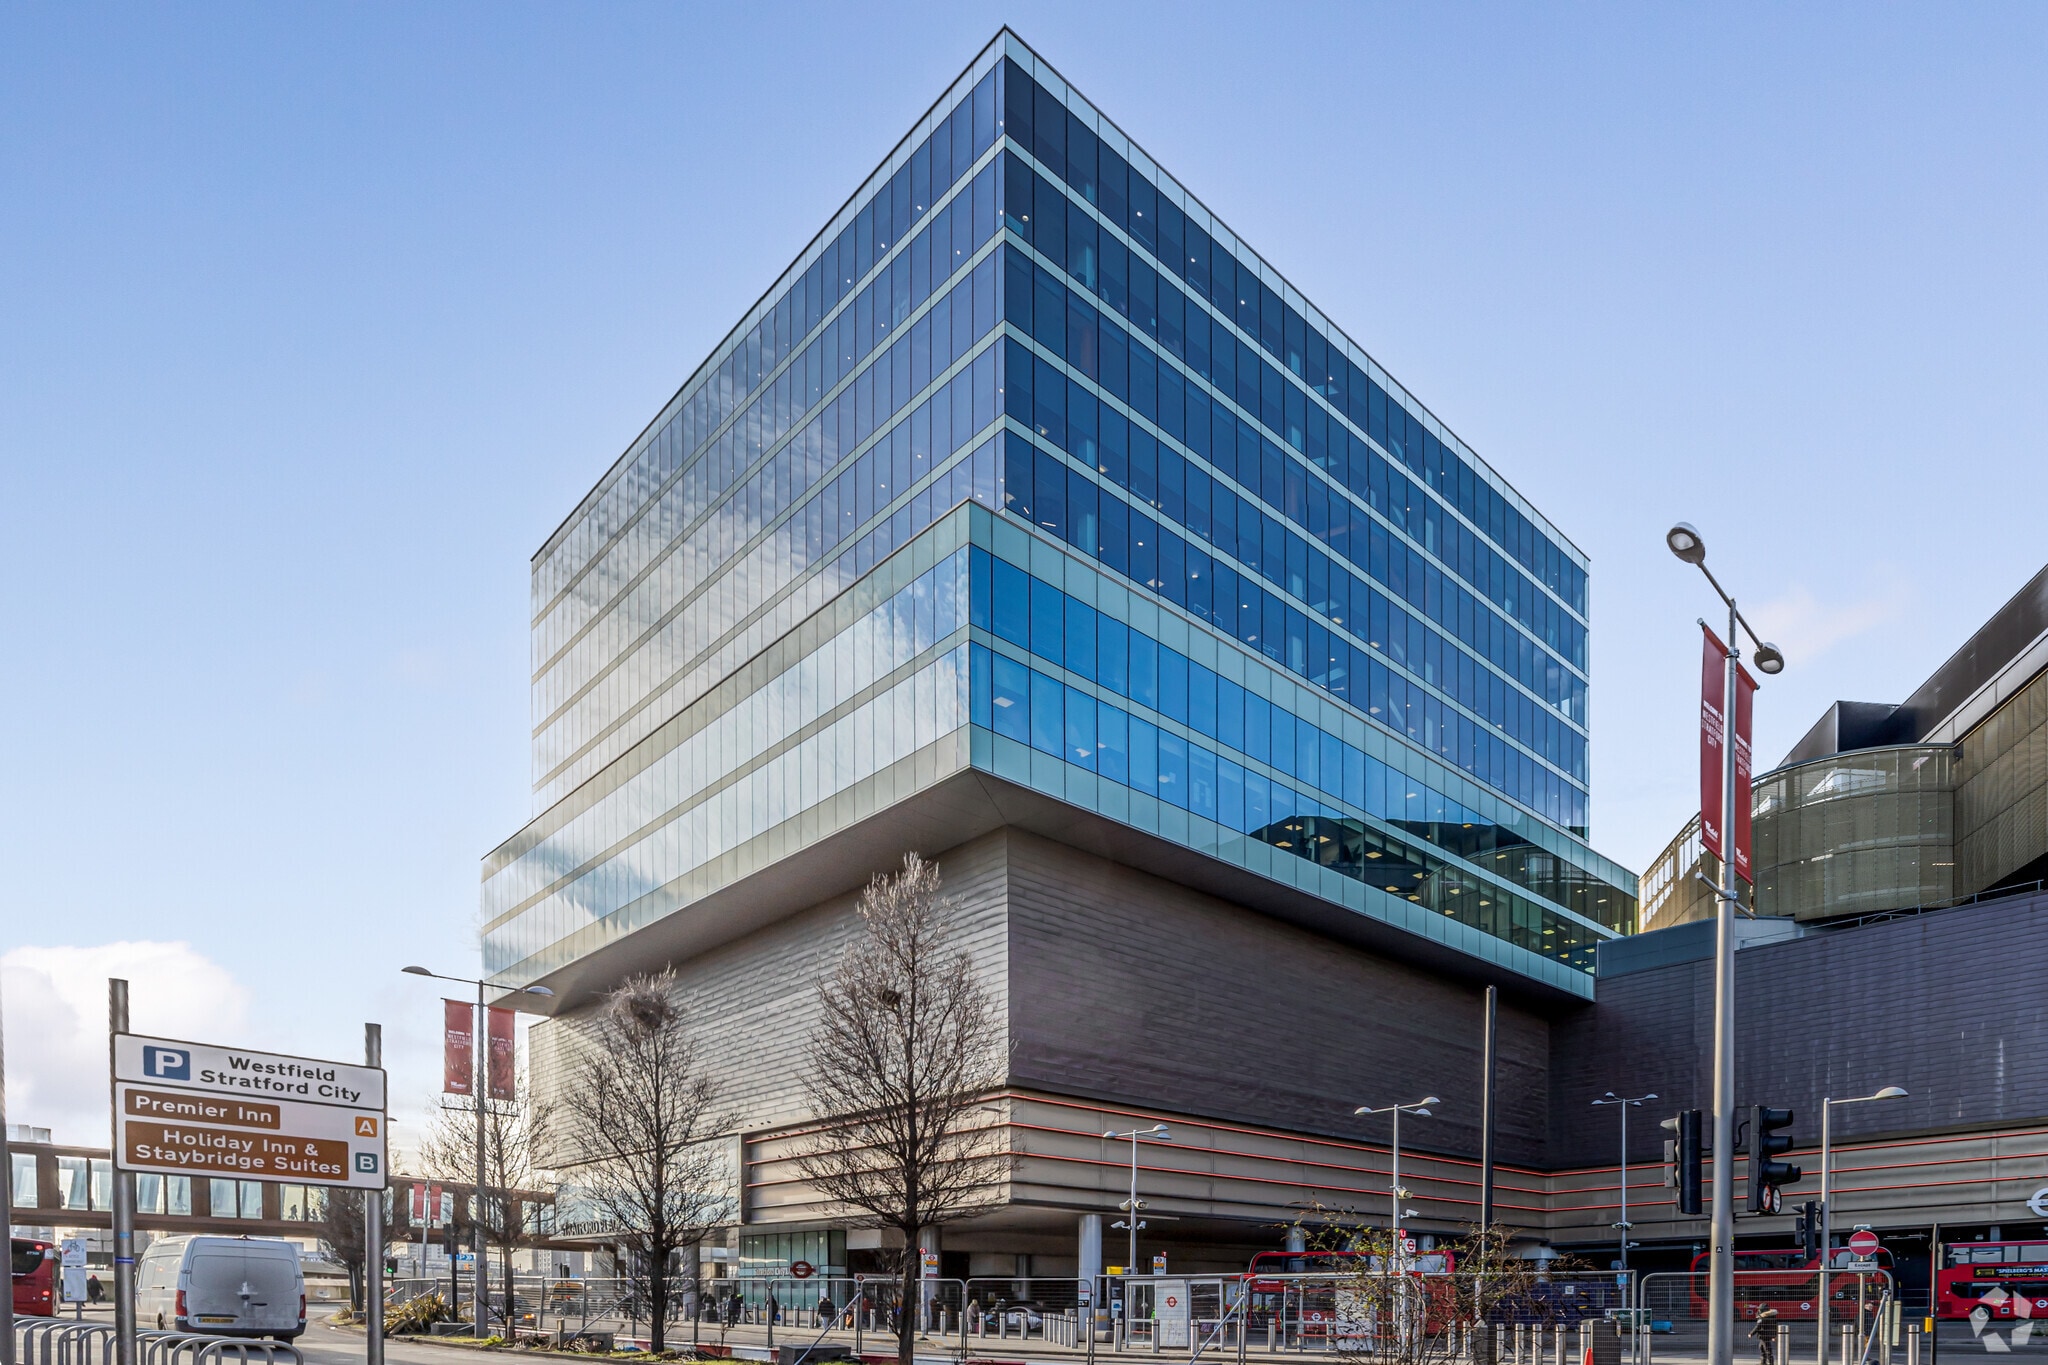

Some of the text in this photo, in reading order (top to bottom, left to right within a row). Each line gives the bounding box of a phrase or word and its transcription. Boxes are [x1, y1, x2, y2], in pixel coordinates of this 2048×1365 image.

[155, 1051, 183, 1075] P
[228, 1056, 336, 1082] Westfield
[200, 1070, 361, 1102] Stratford City
[135, 1095, 272, 1123] Premier Inn
[359, 1120, 374, 1135] A
[163, 1129, 318, 1157] Holiday Inn &
[135, 1144, 341, 1175] Staybridge Suites
[360, 1156, 375, 1170] B
